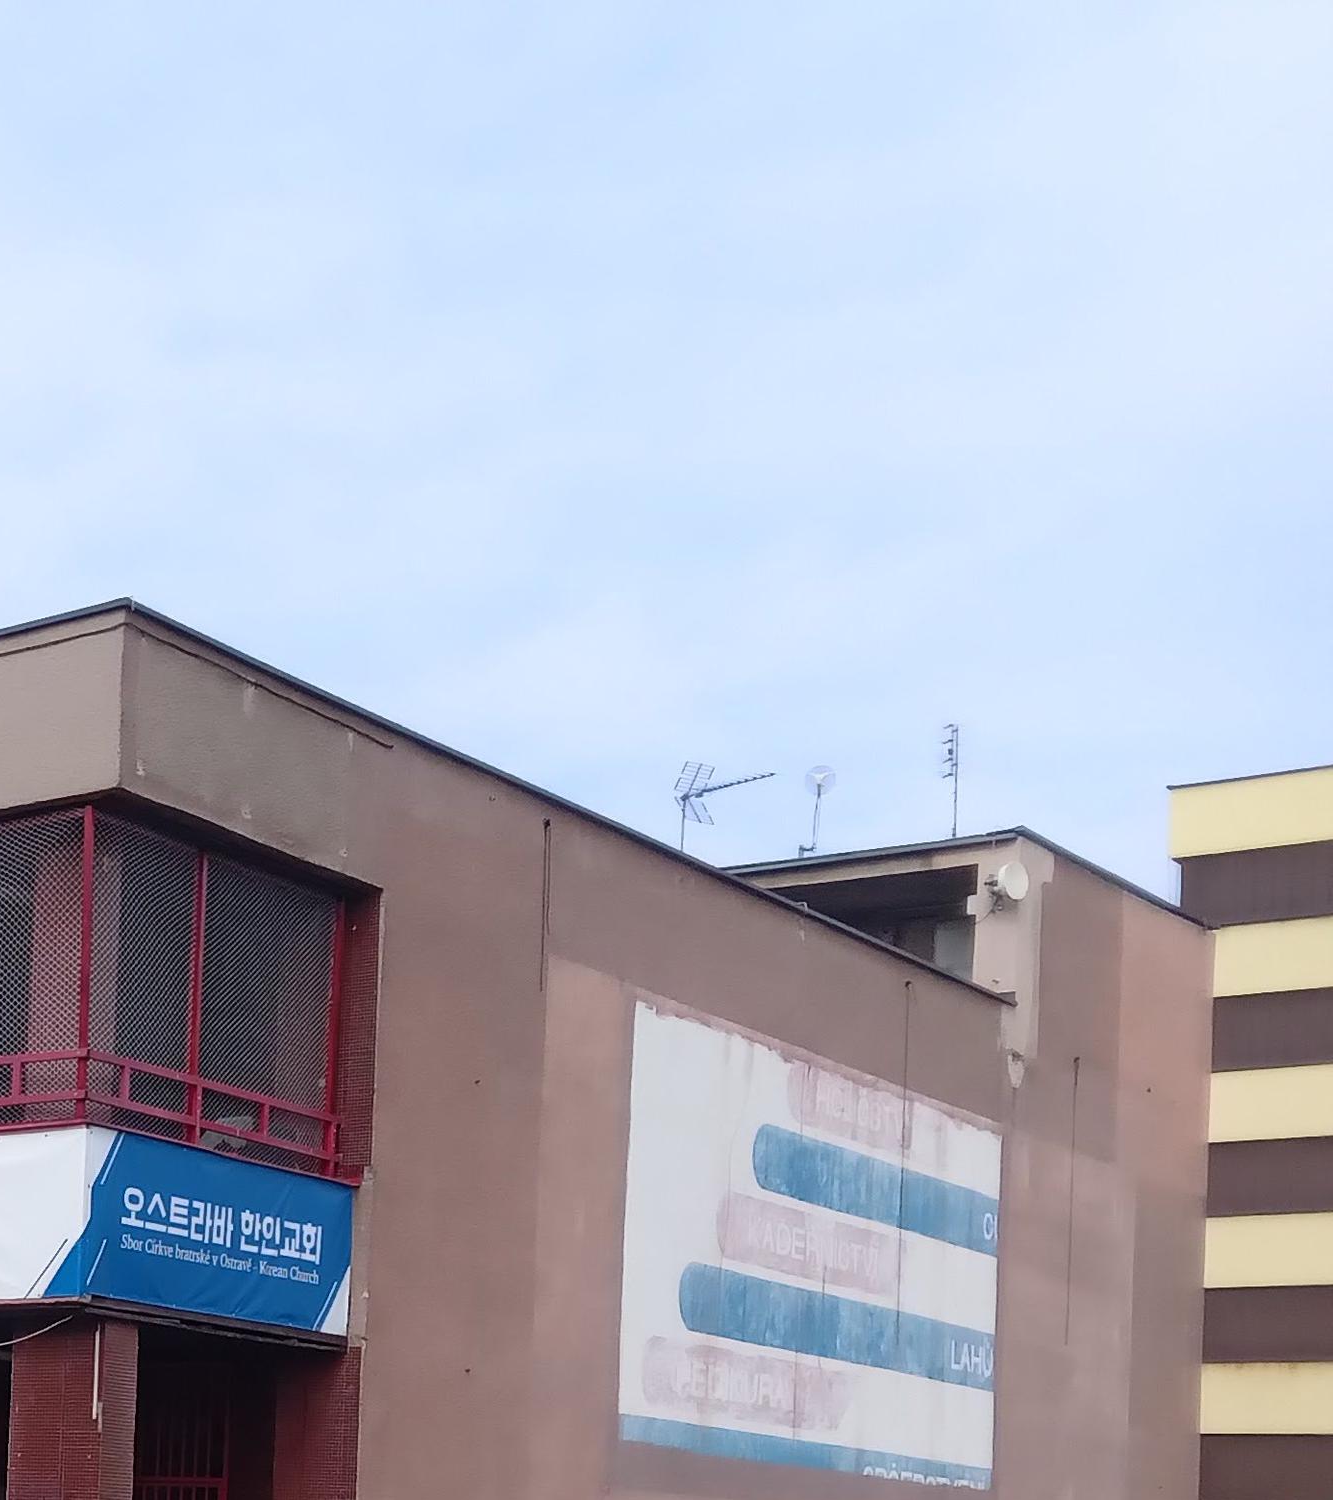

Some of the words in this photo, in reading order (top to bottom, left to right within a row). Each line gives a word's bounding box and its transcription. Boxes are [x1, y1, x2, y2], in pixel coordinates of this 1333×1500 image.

[121, 1187, 233, 1248] 오스트라바
[240, 1209, 322, 1265] 한인교회
[120, 1234, 144, 1251] Sbor
[144, 1238, 174, 1258] Církve
[174, 1243, 211, 1265] bratrské
[212, 1255, 218, 1266] v
[219, 1252, 253, 1273] Ostravě
[259, 1260, 289, 1279] Korean
[289, 1265, 320, 1285] Church
